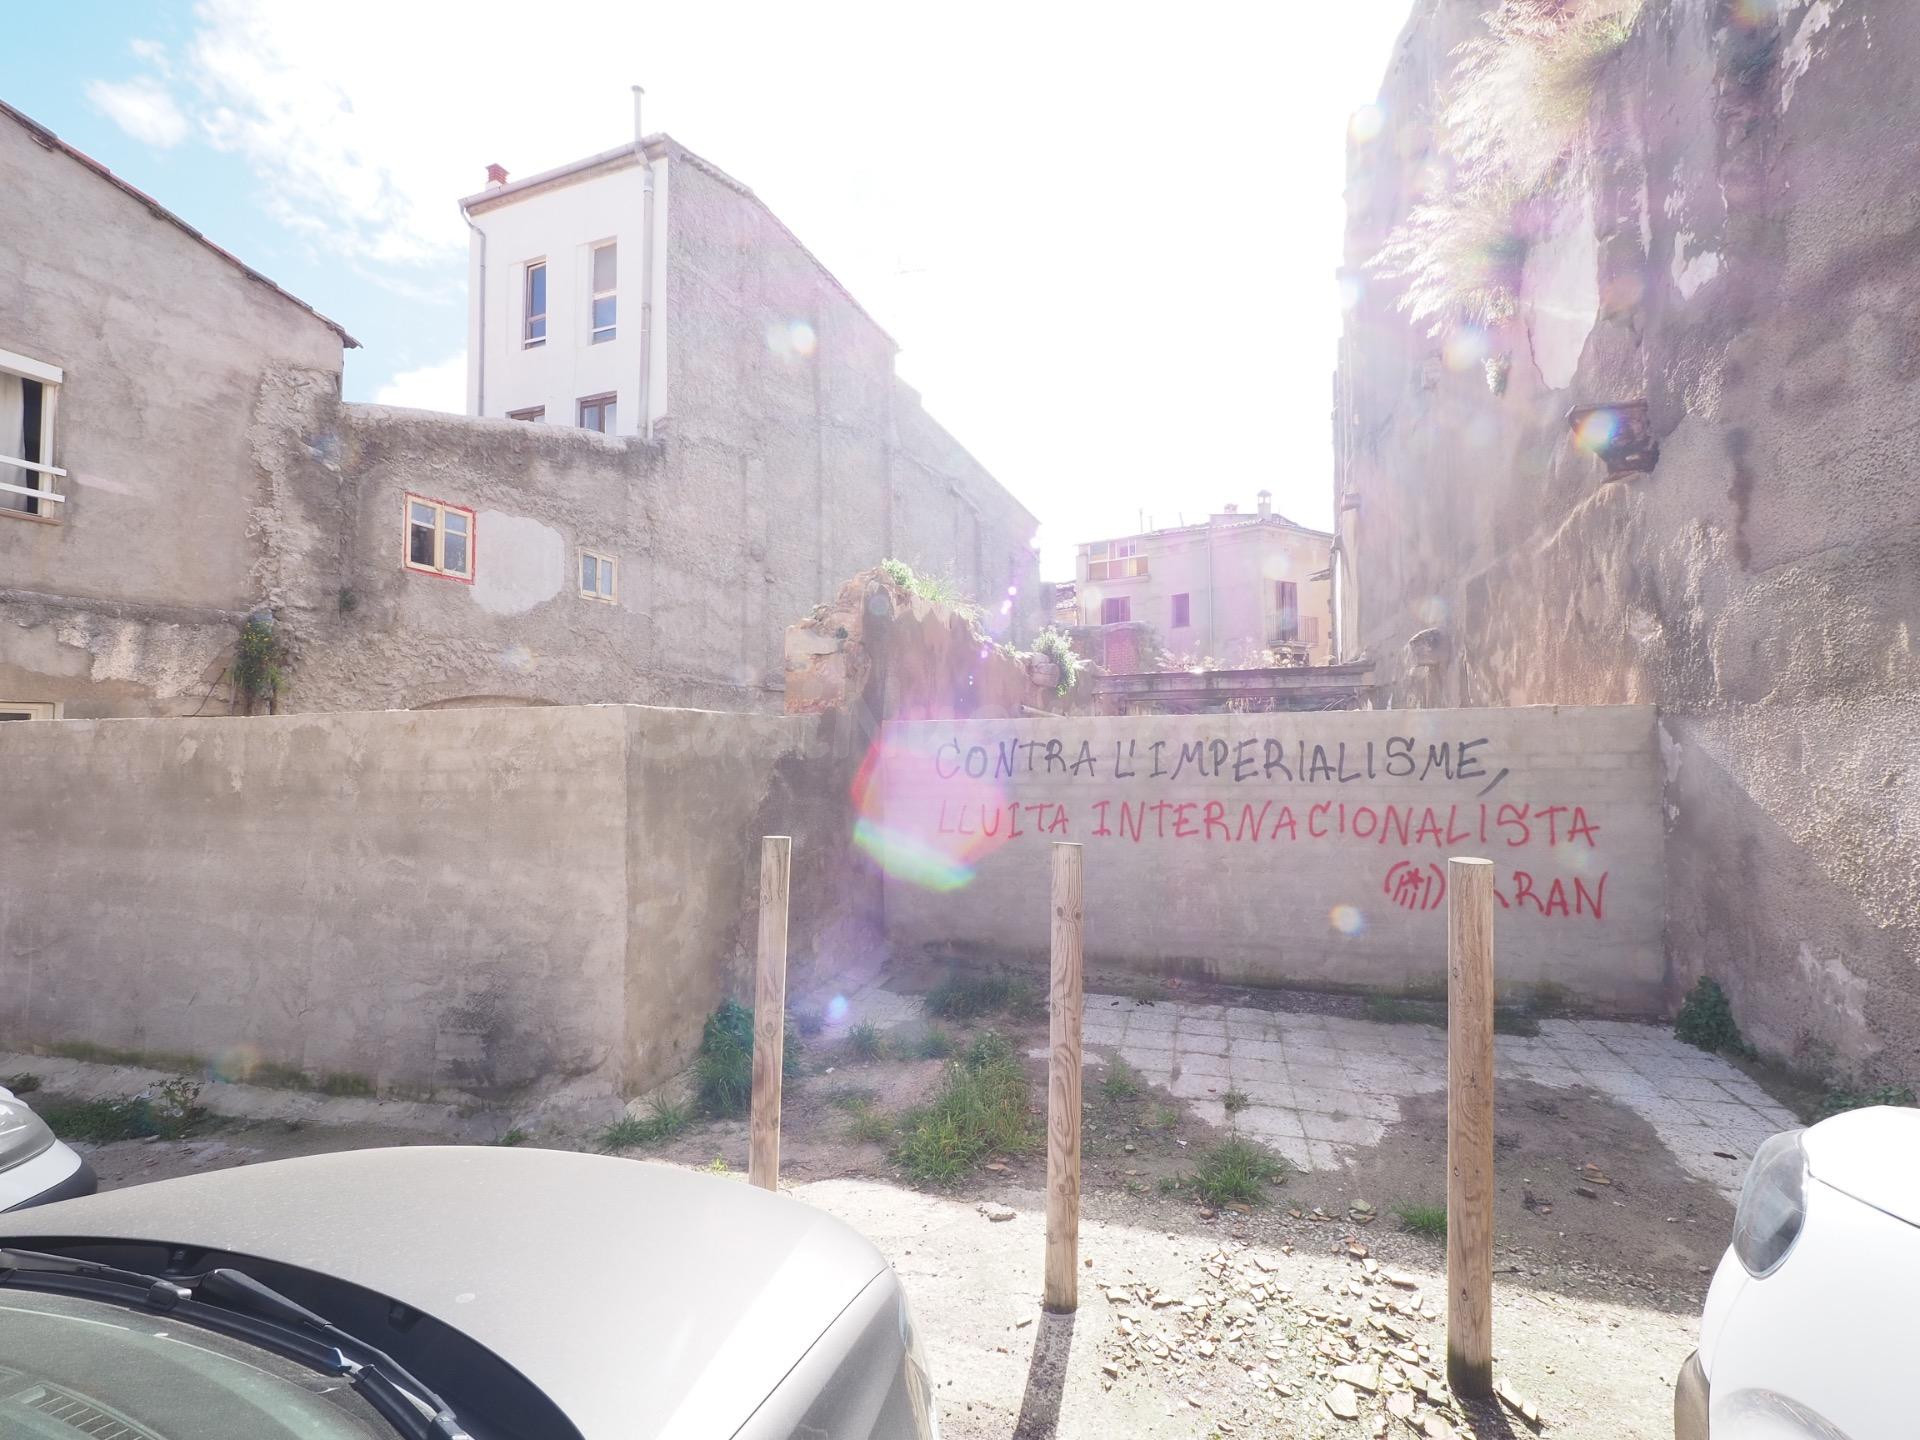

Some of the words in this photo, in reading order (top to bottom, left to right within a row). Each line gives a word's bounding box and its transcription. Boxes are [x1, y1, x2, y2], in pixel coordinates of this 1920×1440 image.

[936, 738, 1097, 779] CONTRA
[937, 800, 1069, 838] LLUITA
[1091, 800, 1600, 847] INTERNACIONALISTA
